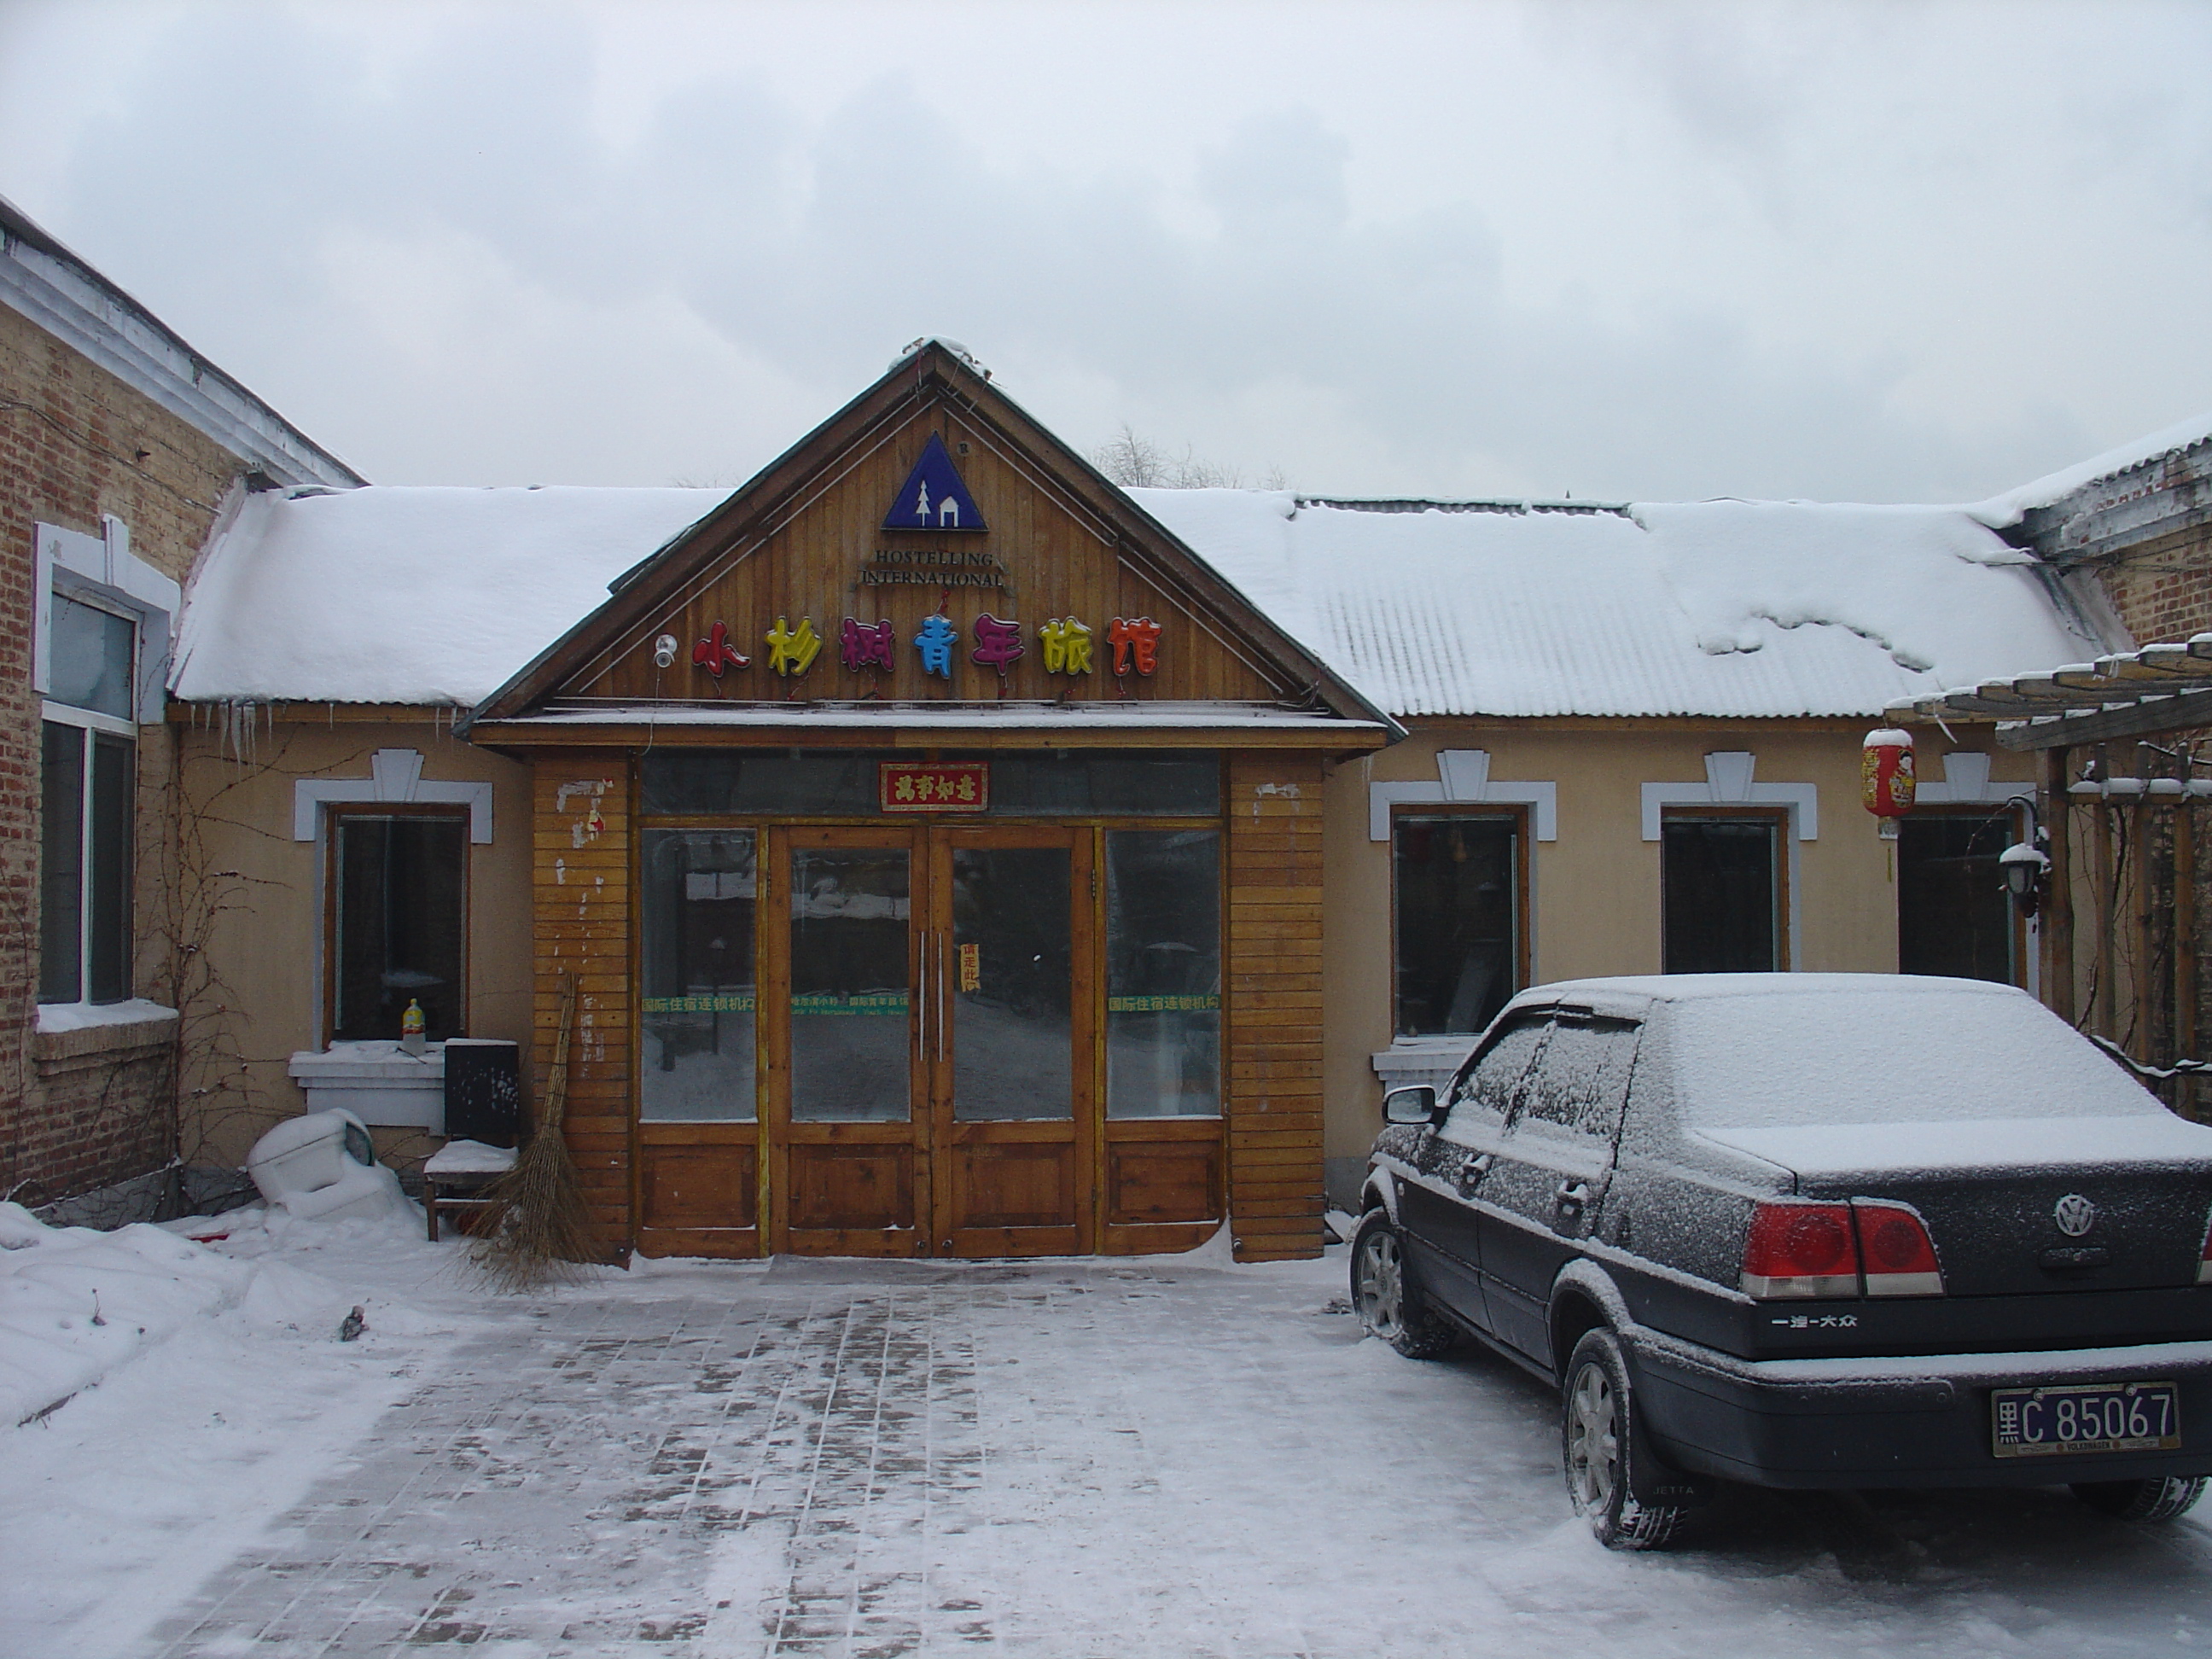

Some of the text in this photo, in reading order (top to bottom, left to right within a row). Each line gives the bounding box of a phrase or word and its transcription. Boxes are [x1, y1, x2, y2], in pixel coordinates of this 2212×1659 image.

[876, 550, 993, 567] HOSTELLING
[861, 570, 1004, 587] INTERNATIONAL
[692, 613, 1163, 679] 小杉树青年旅馆
[894, 774, 976, 801] 萬事如意
[1109, 997, 1219, 1012] 国际住宿连锁机构
[1652, 1486, 1694, 1495] JETTA
